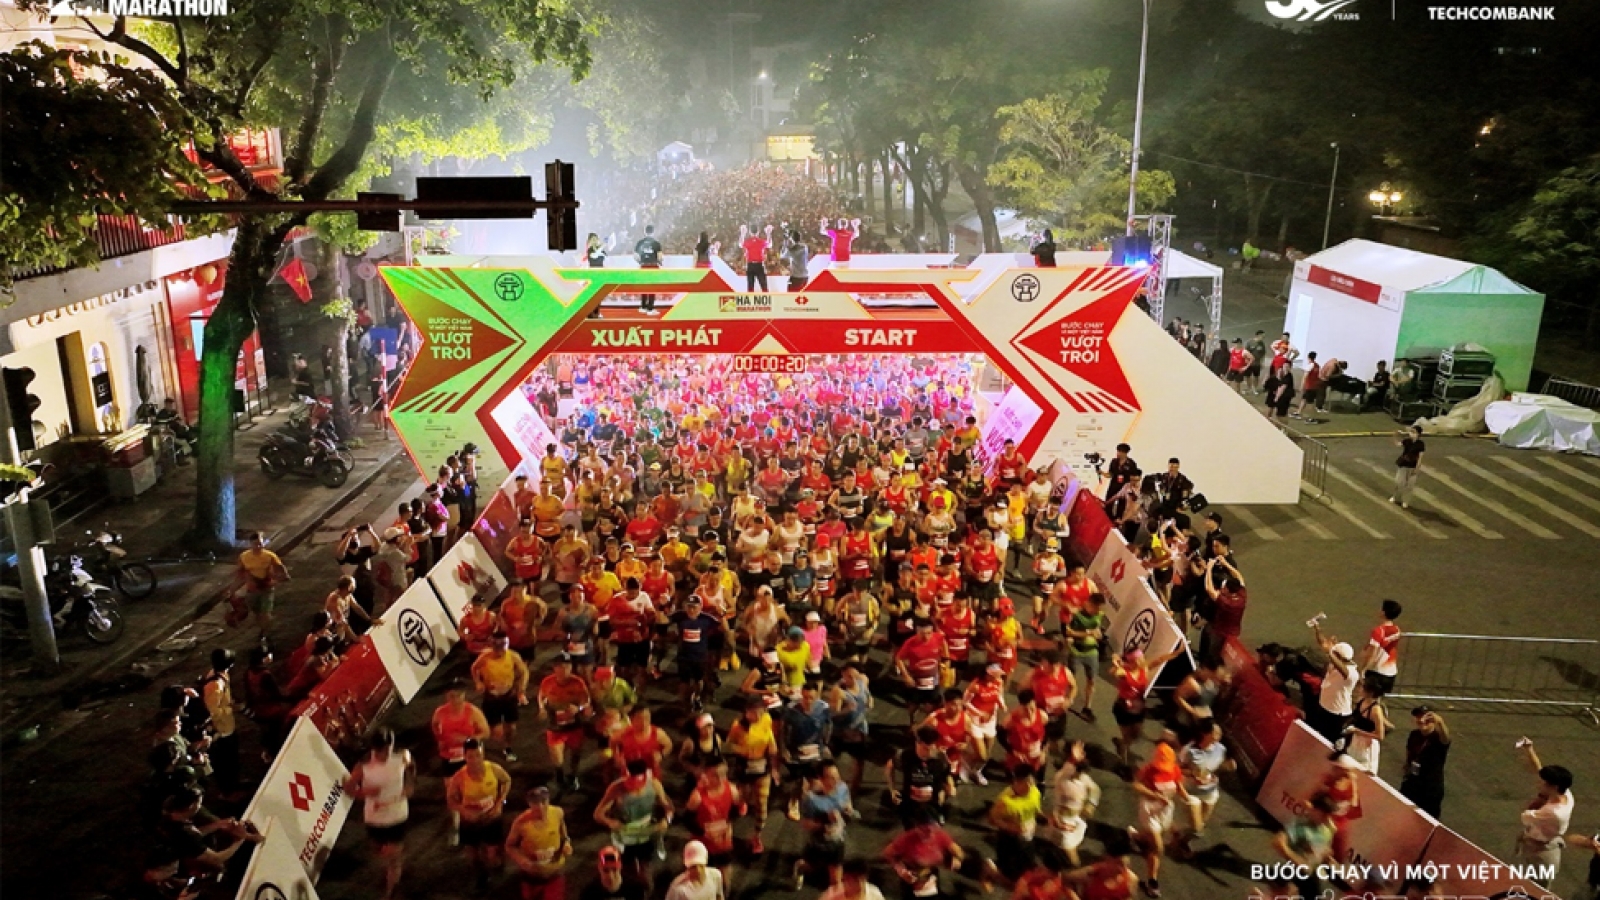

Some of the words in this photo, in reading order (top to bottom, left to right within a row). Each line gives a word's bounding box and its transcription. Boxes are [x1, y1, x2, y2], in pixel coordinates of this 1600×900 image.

[591, 325, 654, 346] XUẤT
[660, 325, 723, 346] PHÁT
[844, 328, 917, 346] START
[735, 355, 804, 371] 00:00:20
[299, 779, 344, 867] TECHCOMBANK
